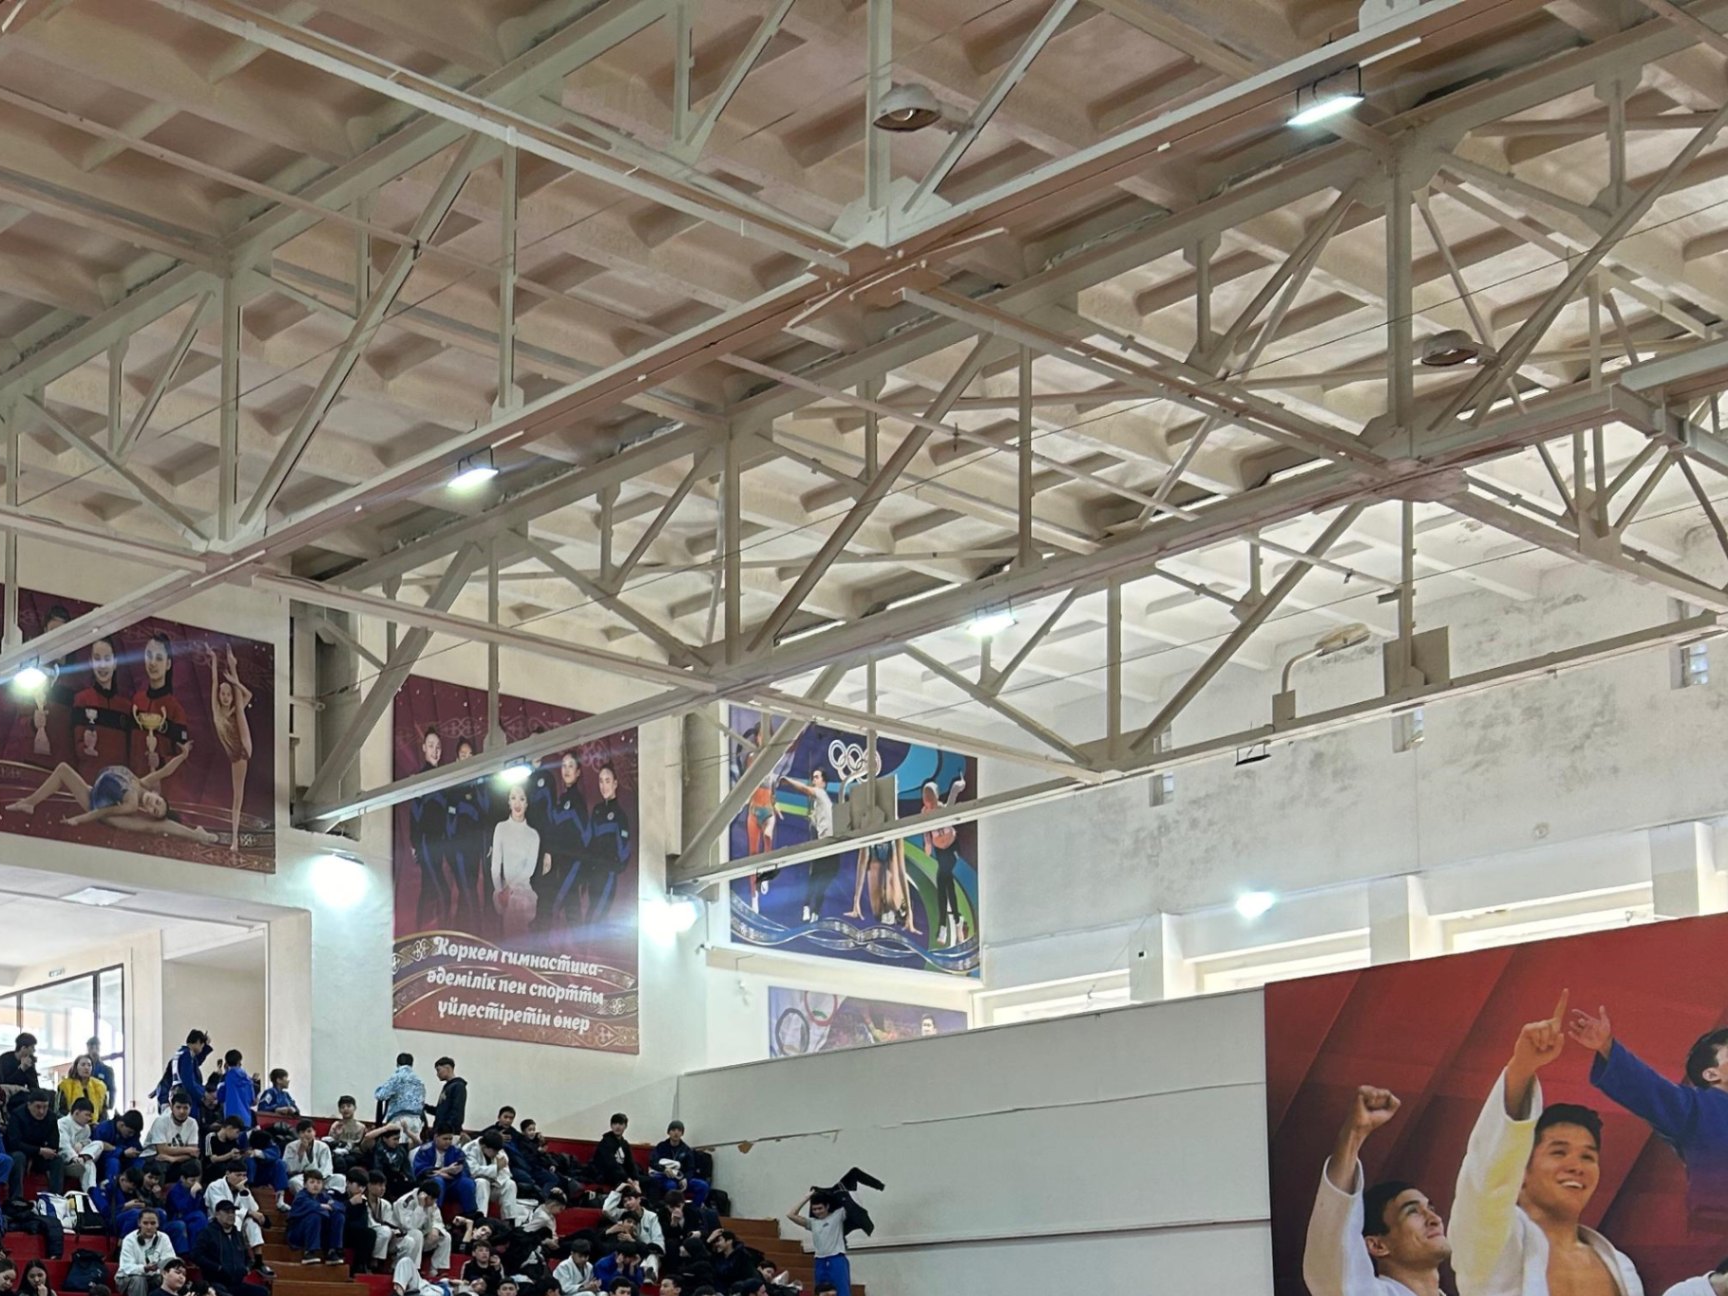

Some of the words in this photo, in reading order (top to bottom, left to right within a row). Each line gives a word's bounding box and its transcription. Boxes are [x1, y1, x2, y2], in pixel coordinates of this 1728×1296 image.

[433, 936, 499, 962] Көркем
[427, 966, 496, 991] әдемілік
[498, 978, 527, 995] пен
[529, 983, 604, 1005] спортты
[438, 996, 551, 1026] үйлестіретін
[553, 1015, 590, 1035] өнер
